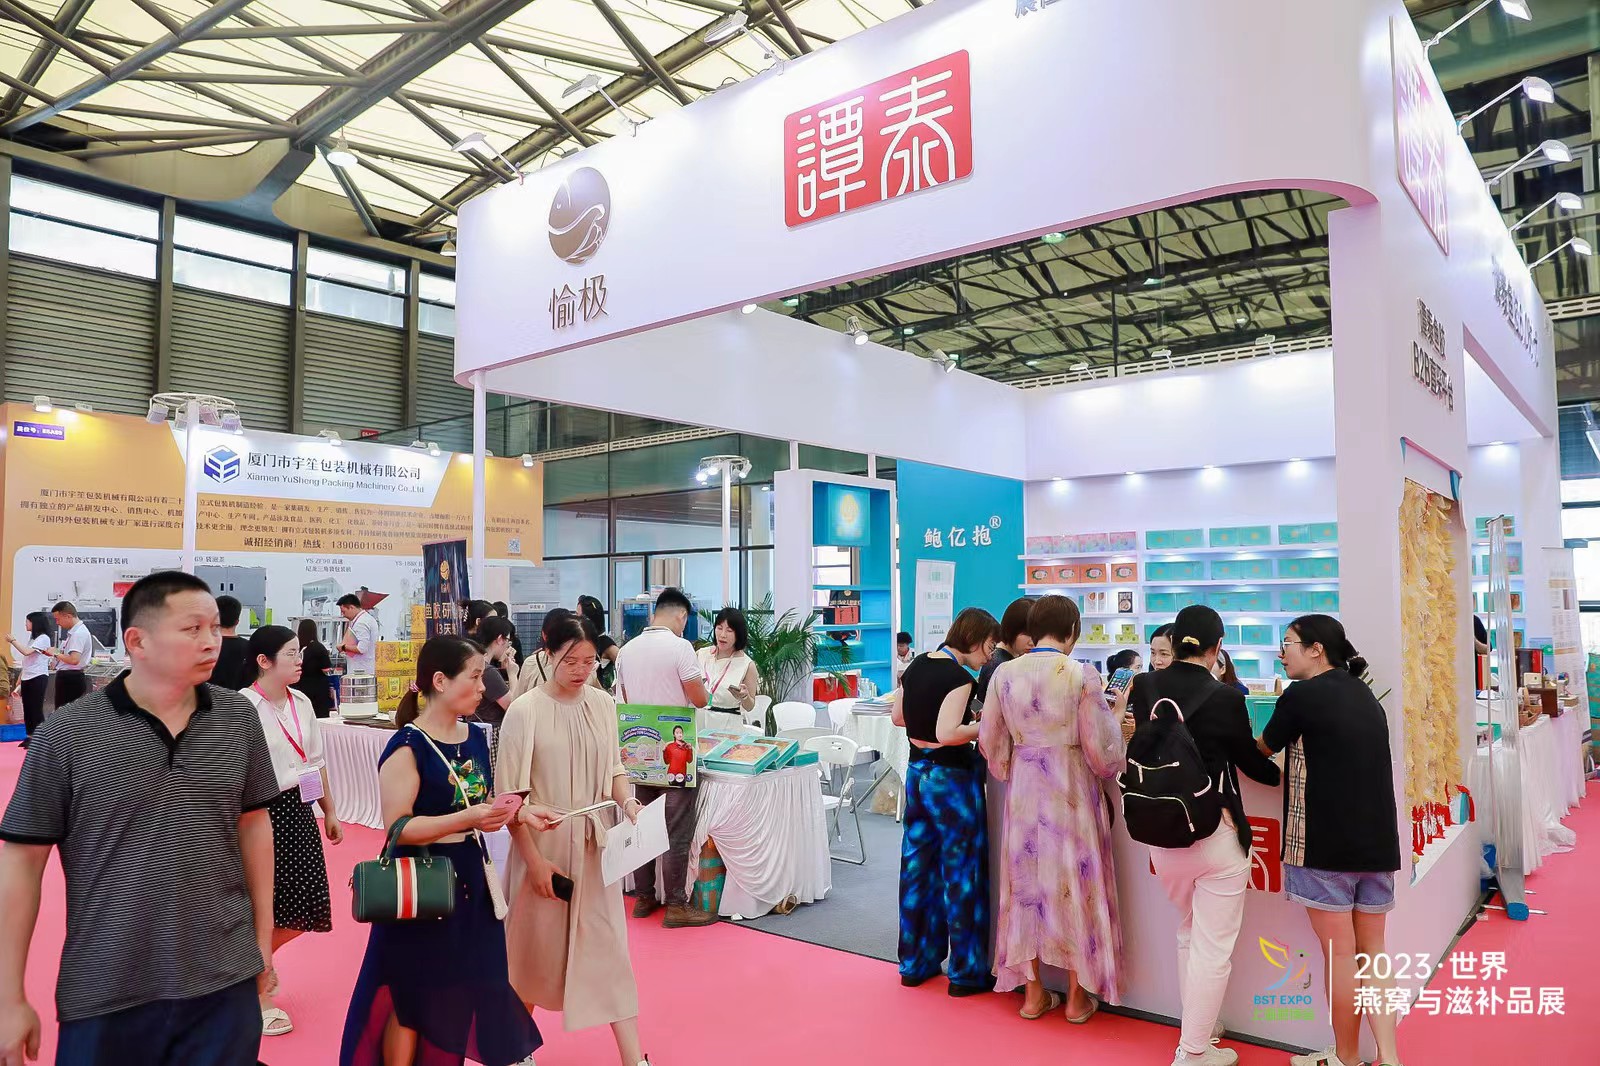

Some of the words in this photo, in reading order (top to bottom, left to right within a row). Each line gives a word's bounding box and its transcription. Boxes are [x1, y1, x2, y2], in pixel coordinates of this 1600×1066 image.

[549, 274, 609, 330] 愉极
[248, 452, 421, 480] 厦门市宇笙包装机械有限公司
[247, 472, 280, 483] Xiamen
[282, 475, 320, 487] YuSheng
[322, 478, 354, 489] Packing
[356, 480, 395, 493] Machinery
